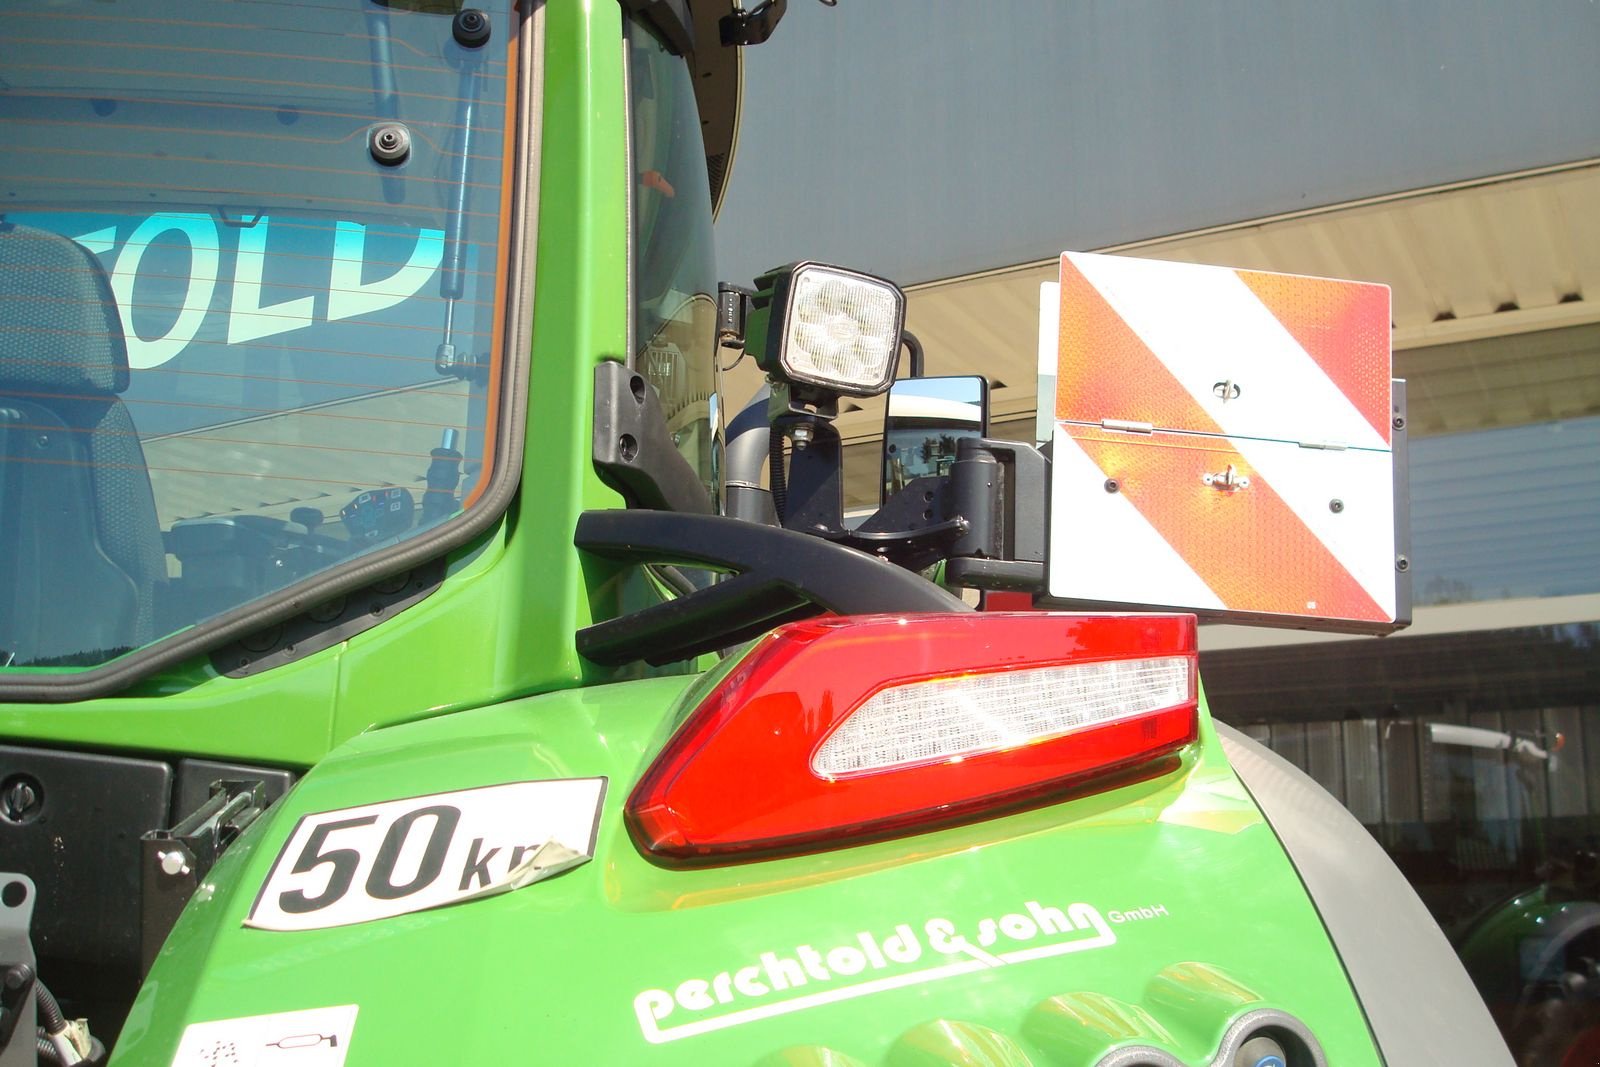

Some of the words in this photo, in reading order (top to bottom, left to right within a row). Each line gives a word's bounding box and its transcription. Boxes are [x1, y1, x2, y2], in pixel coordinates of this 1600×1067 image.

[70, 212, 445, 370] OLD
[278, 805, 462, 914] 50
[633, 924, 922, 1044] perchtold
[977, 901, 1117, 948] sohn
[1107, 904, 1169, 924] GmbH
